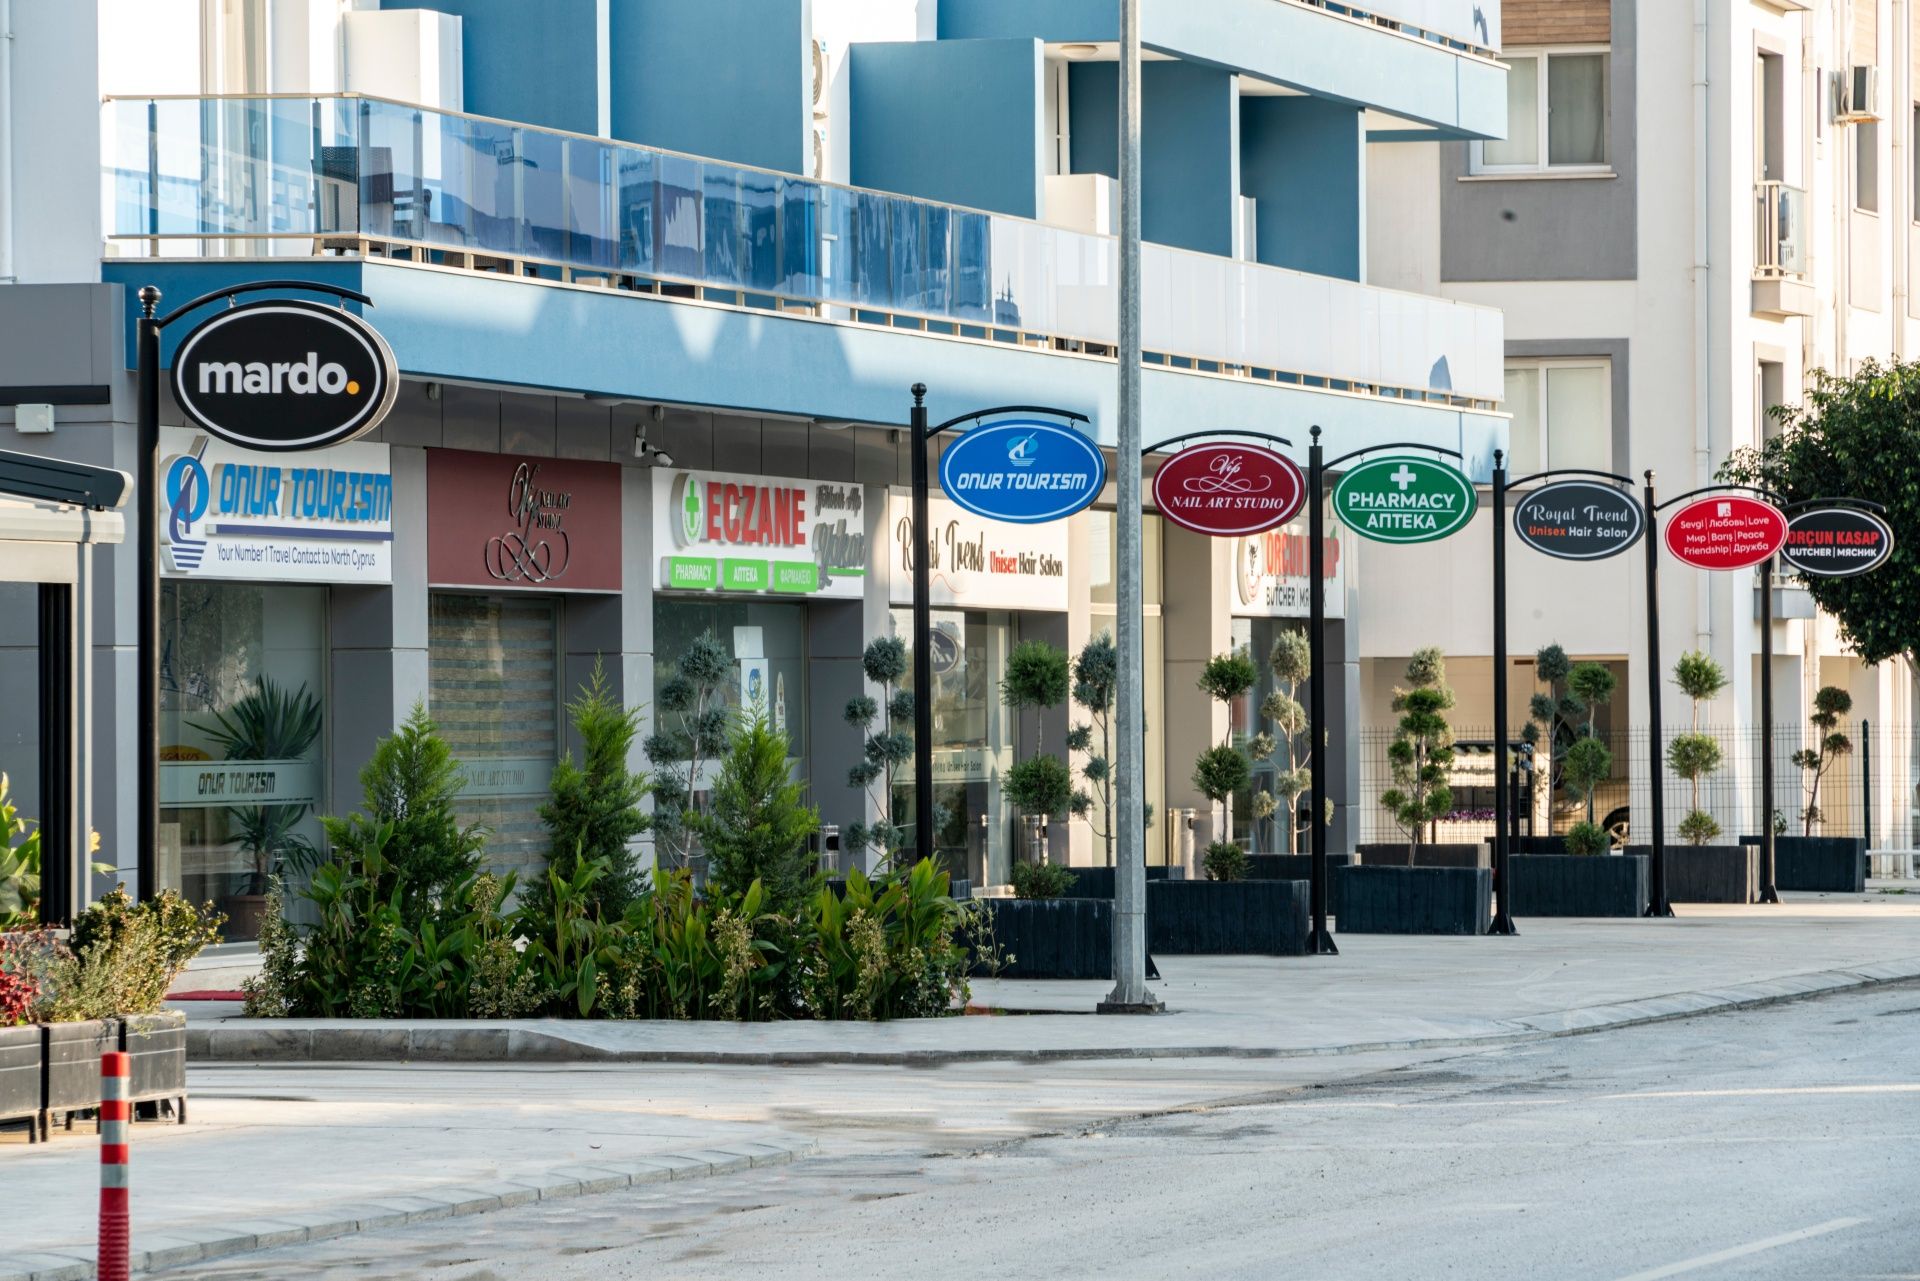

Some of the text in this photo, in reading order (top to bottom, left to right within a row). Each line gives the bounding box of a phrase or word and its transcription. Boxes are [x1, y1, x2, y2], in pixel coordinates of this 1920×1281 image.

[199, 352, 360, 395] mardo.
[957, 473, 1088, 490] ONUR TOURISM
[218, 463, 392, 522] ONUR TOURISM
[1348, 492, 1455, 509] PHARMACY
[1171, 496, 1284, 510] NAIL ART STUDIO
[706, 481, 806, 545] ECZANE
[1366, 513, 1437, 529] АПТЕКА
[1527, 504, 1628, 525] Royal Trend
[1748, 516, 1770, 526] Love
[1680, 520, 1704, 530] Sevgi
[1709, 518, 1744, 528] Любовь
[1528, 526, 1628, 538] Unisex Hair Salon
[1686, 534, 1706, 544] Мир
[1737, 531, 1765, 540] Peace
[1788, 531, 1880, 547] ORÇUN KASAP
[897, 516, 1063, 577] Ral Trend Unisex Hair Salon
[1684, 544, 1729, 556] Friendship
[1733, 542, 1769, 554] Дружба
[1789, 548, 1832, 556] BUTCHER
[1837, 548, 1877, 557] МЯСНИК
[217, 543, 233, 561] Your
[234, 544, 263, 562] Number
[269, 545, 290, 563] Travel
[292, 546, 320, 564] Contact
[322, 548, 330, 564] to
[331, 548, 350, 565] North
[352, 549, 376, 570] Cyprus
[675, 564, 712, 581] PHARMACY
[1266, 586, 1296, 606] BUTCHER
[198, 771, 275, 795] ONUR TOURISM
